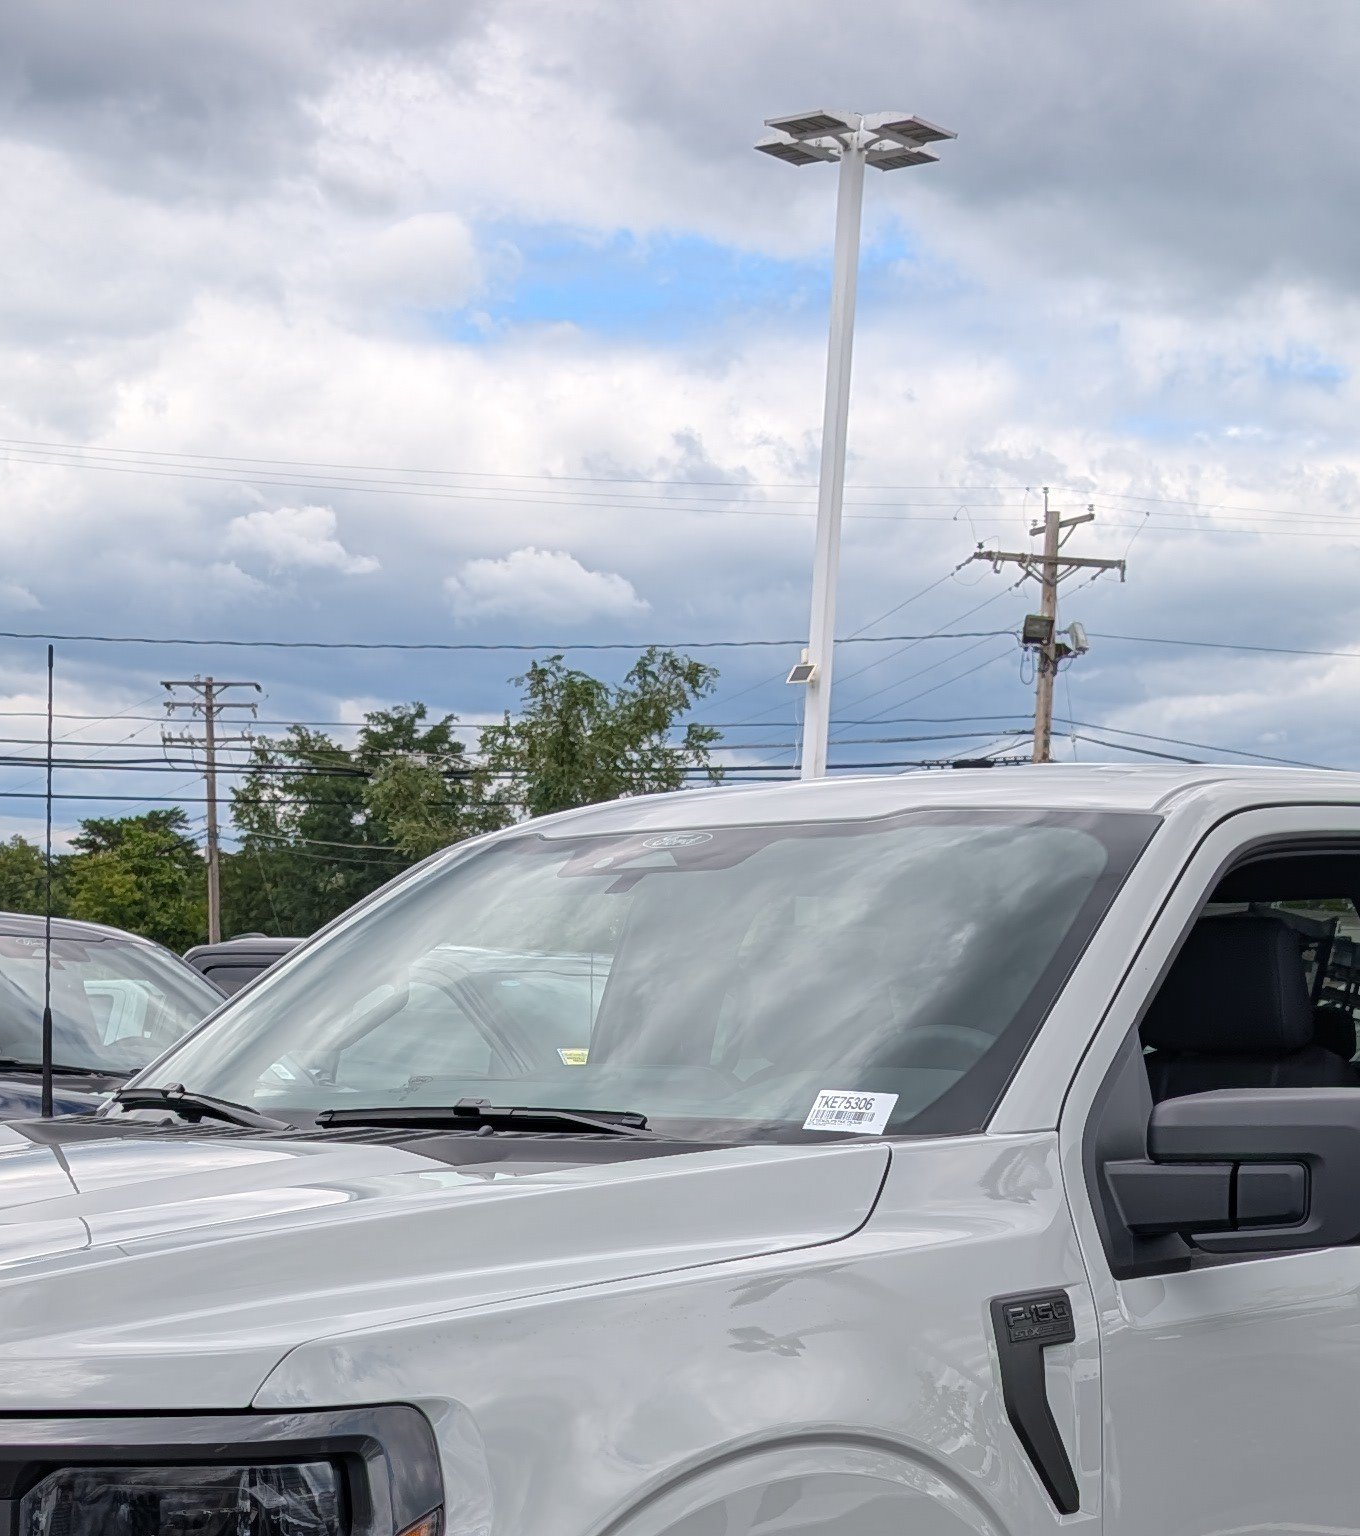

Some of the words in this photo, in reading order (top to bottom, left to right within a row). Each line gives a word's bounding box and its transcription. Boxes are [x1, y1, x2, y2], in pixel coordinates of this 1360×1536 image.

[651, 832, 703, 847] Ford
[817, 1095, 876, 1111] TKE75306
[1004, 1300, 1071, 1328] F-150
[1014, 1326, 1041, 1339] STX
